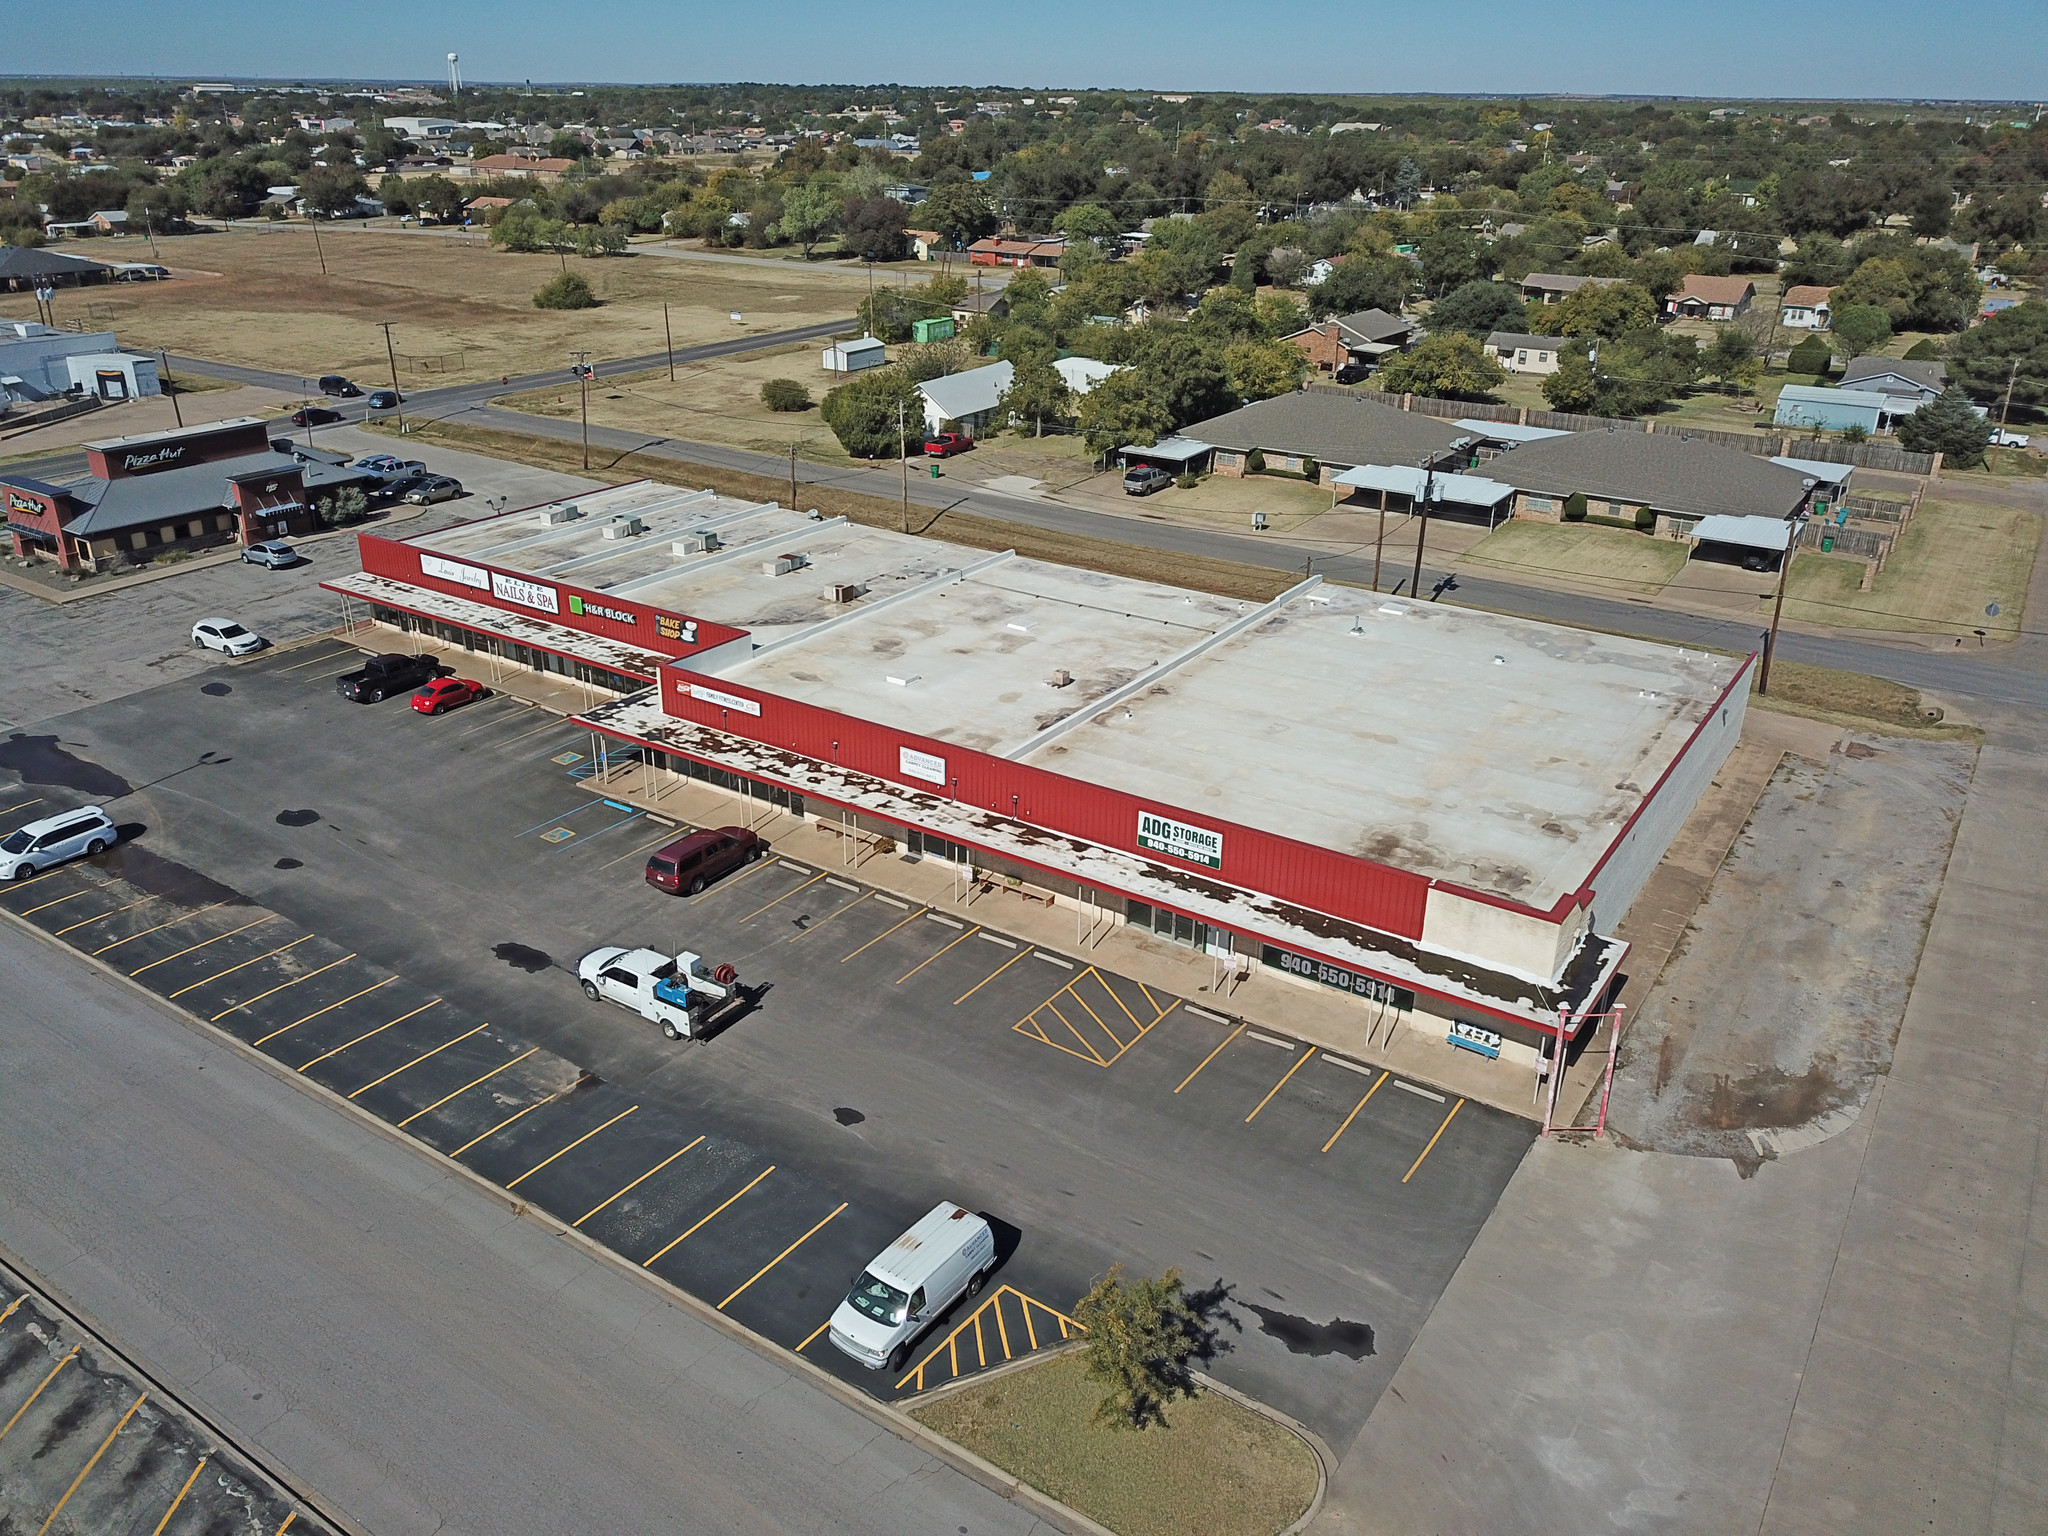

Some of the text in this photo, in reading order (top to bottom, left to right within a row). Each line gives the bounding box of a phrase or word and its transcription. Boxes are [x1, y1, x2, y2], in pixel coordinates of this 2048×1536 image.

[124, 446, 186, 469] Pizza Hut
[10, 493, 43, 513] Pizza Hut
[505, 578, 543, 593] ELITE
[495, 582, 555, 610] NAILS & SPA
[585, 603, 636, 624] H&R BLOCK
[660, 617, 681, 630] BAKE
[660, 627, 681, 639] SHOP
[905, 759, 921, 768] CARPET
[922, 764, 942, 774] CLEANING
[910, 754, 942, 768] ADVANCED
[1142, 816, 1171, 840] ADG
[1173, 826, 1218, 849] STORAGE
[1147, 838, 1210, 864] 940-550-5914
